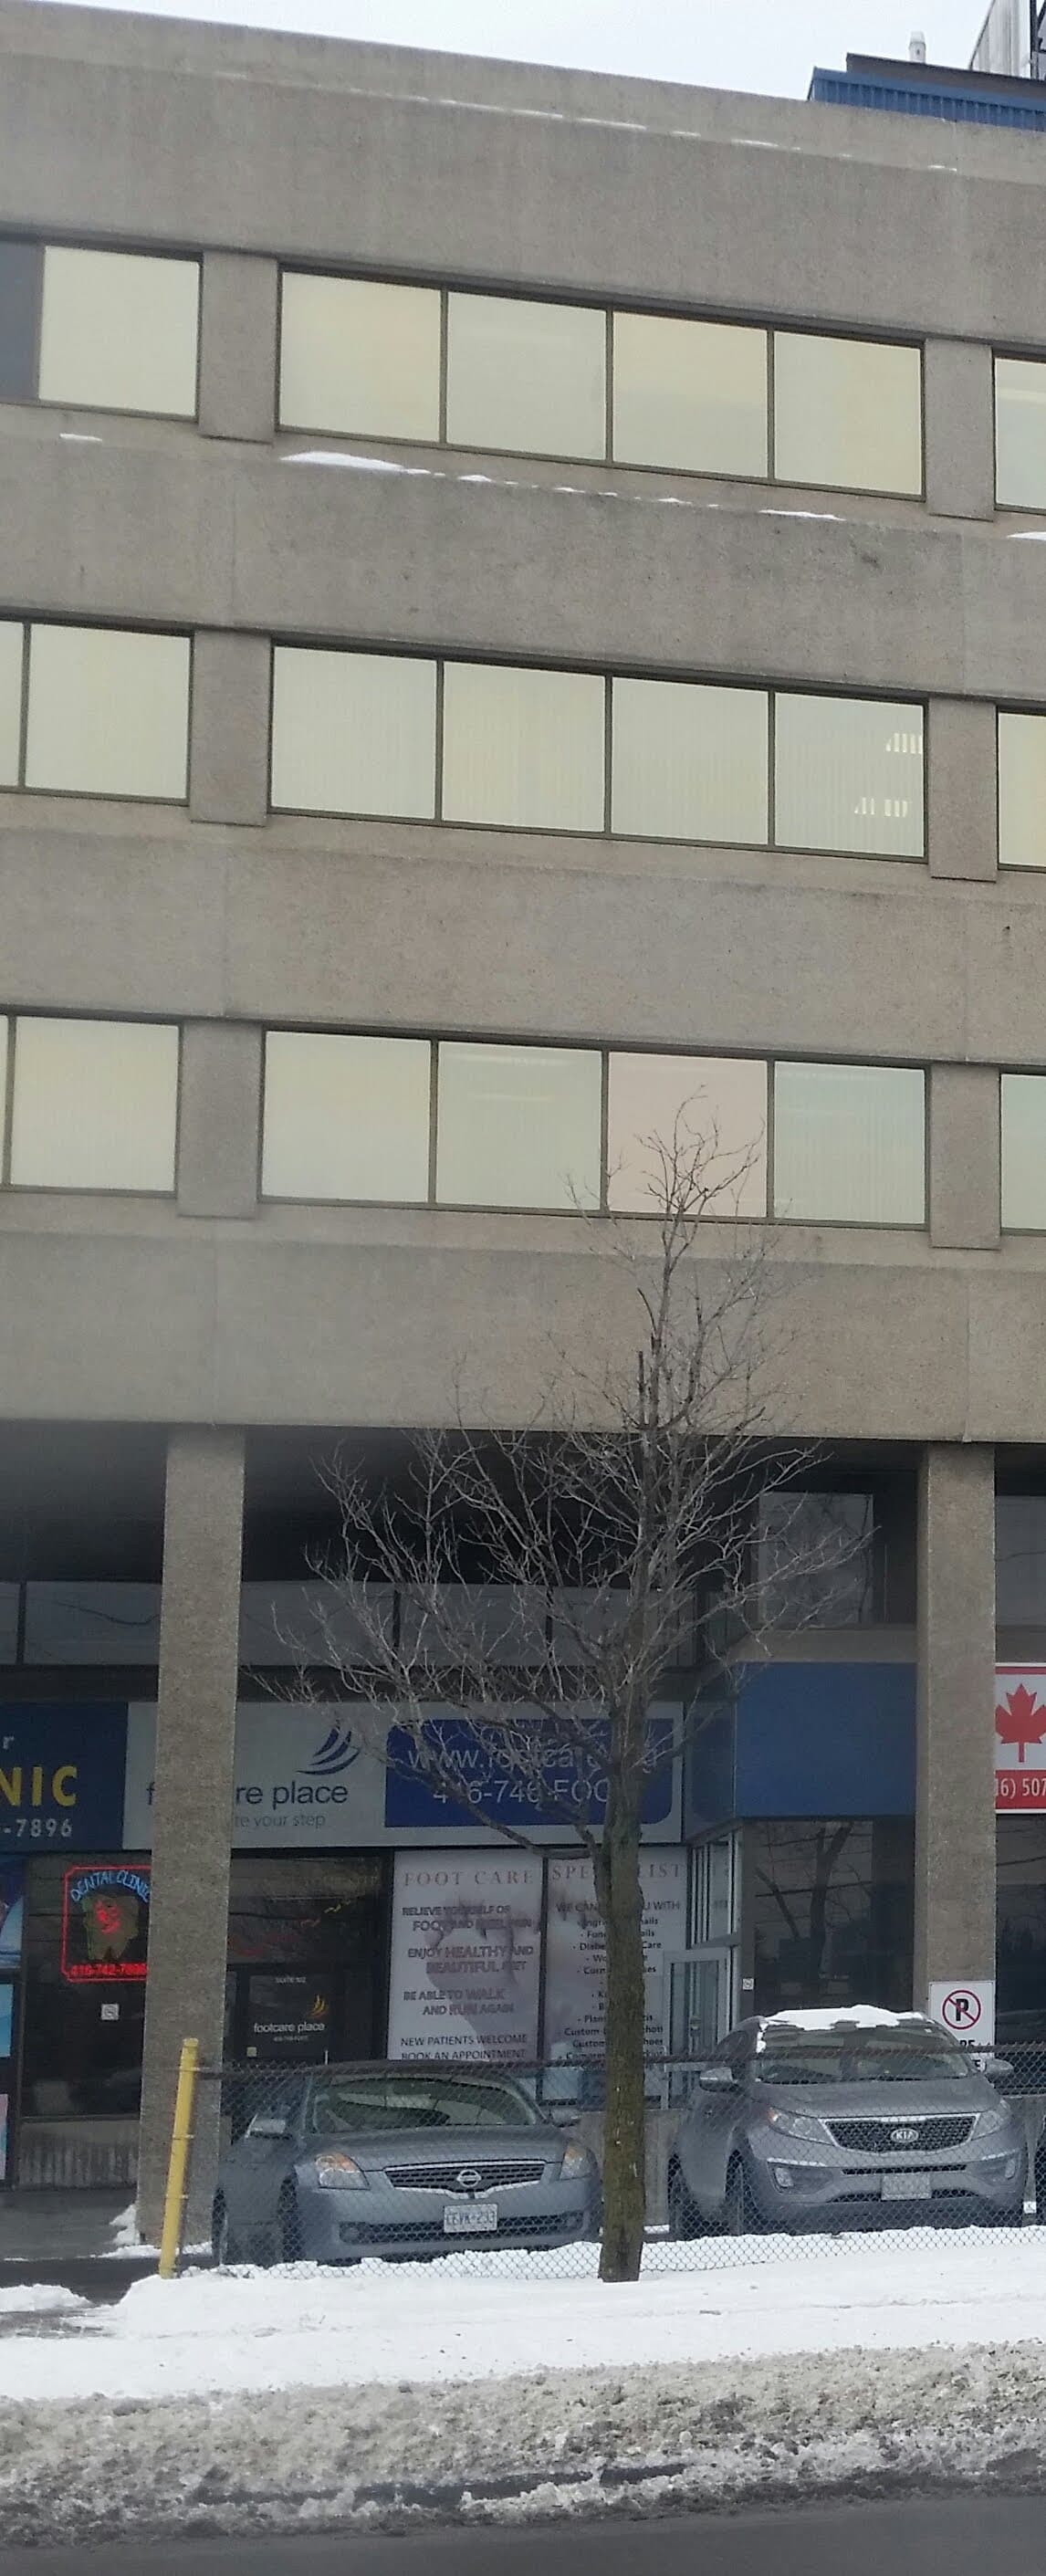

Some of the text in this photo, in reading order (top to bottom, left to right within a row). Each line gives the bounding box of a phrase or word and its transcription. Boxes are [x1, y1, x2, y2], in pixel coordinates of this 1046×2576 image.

[273, 1781, 349, 1810] place
[293, 1813, 326, 1829] step
[404, 1870, 533, 1886] FOOT CARE
[70, 1870, 113, 1902] DENTAL
[403, 1906, 442, 1916] RELIEVE
[654, 1901, 680, 1911] WITH
[408, 1945, 533, 1960] ENJOY HEALTHY AND
[419, 1991, 445, 2001] ABLE
[447, 1990, 463, 2000] TO
[465, 1988, 506, 2000] WALK
[423, 2005, 446, 2016] AND
[254, 2021, 325, 2033] footcare place
[564, 2027, 600, 2036] Custom
[401, 2034, 527, 2047] NEW PATIENTS WELCOME
[895, 2131, 914, 2140] KIA
